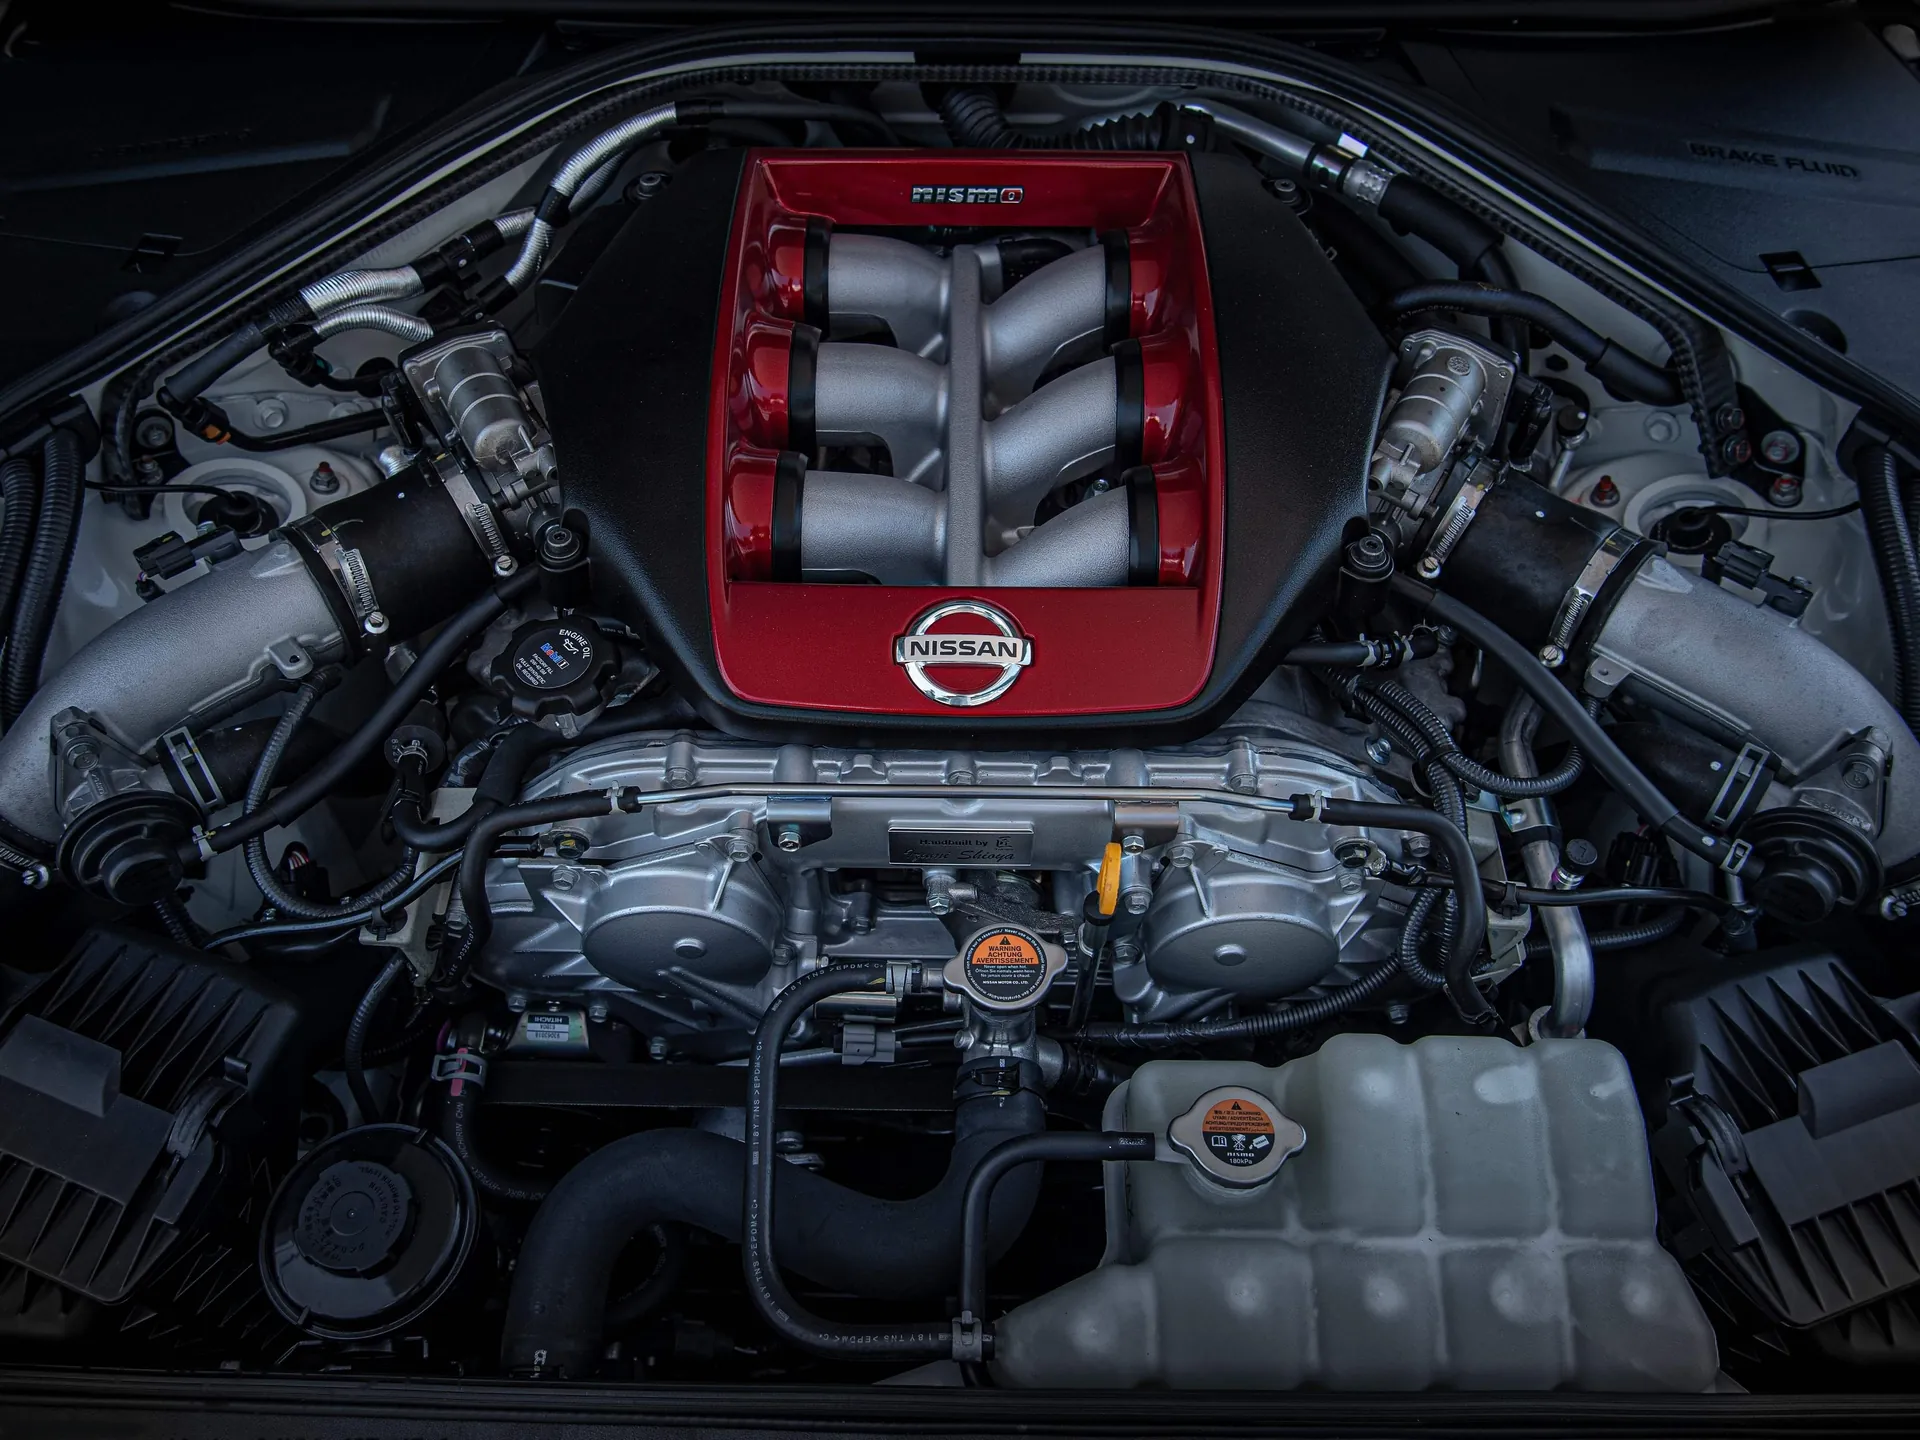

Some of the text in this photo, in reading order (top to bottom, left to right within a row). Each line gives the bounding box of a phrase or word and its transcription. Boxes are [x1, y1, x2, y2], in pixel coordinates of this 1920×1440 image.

[1689, 142, 1858, 178] BRAKE FLUID
[540, 642, 563, 664] Mobil
[559, 628, 592, 659] ENGINE OIL
[910, 640, 1017, 658] NISSAN
[975, 839, 988, 847] by
